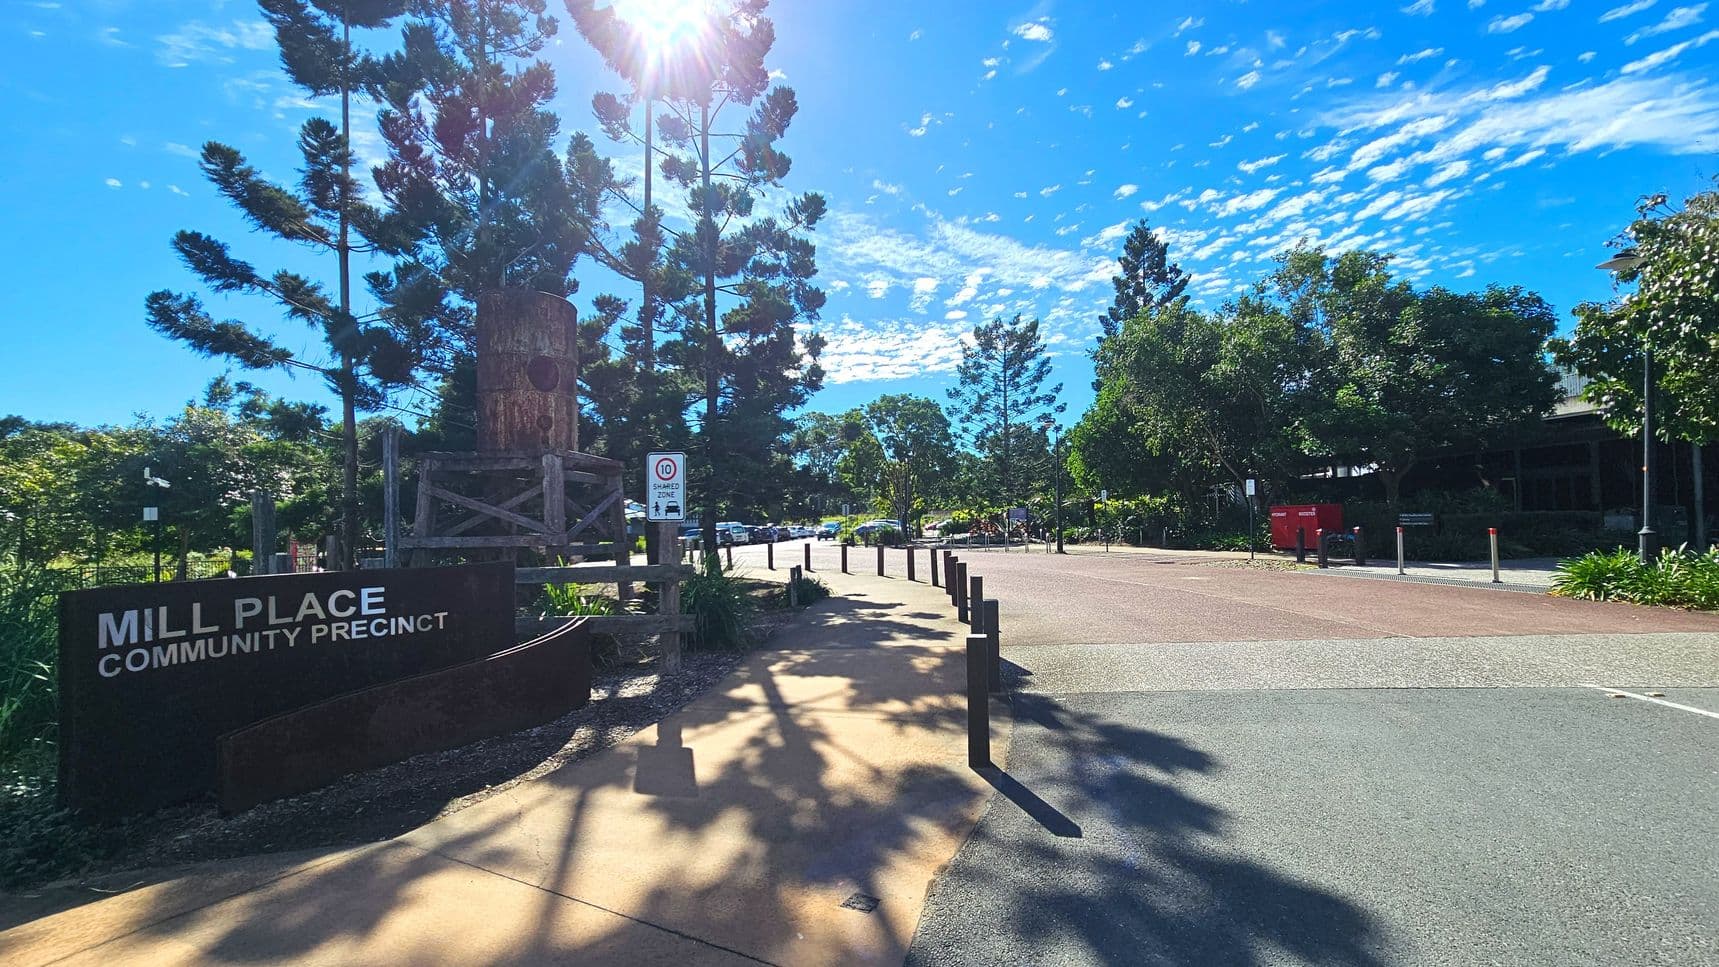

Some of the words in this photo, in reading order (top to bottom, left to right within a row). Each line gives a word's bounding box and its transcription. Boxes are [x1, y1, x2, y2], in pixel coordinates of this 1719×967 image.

[661, 464, 672, 475] 10
[652, 482, 680, 490] SHARED
[657, 491, 675, 499] ZONE
[98, 602, 220, 649] MILL
[234, 587, 386, 629] PLACE
[98, 626, 302, 678] COMMUNITY
[311, 611, 448, 644] PRECINCT
